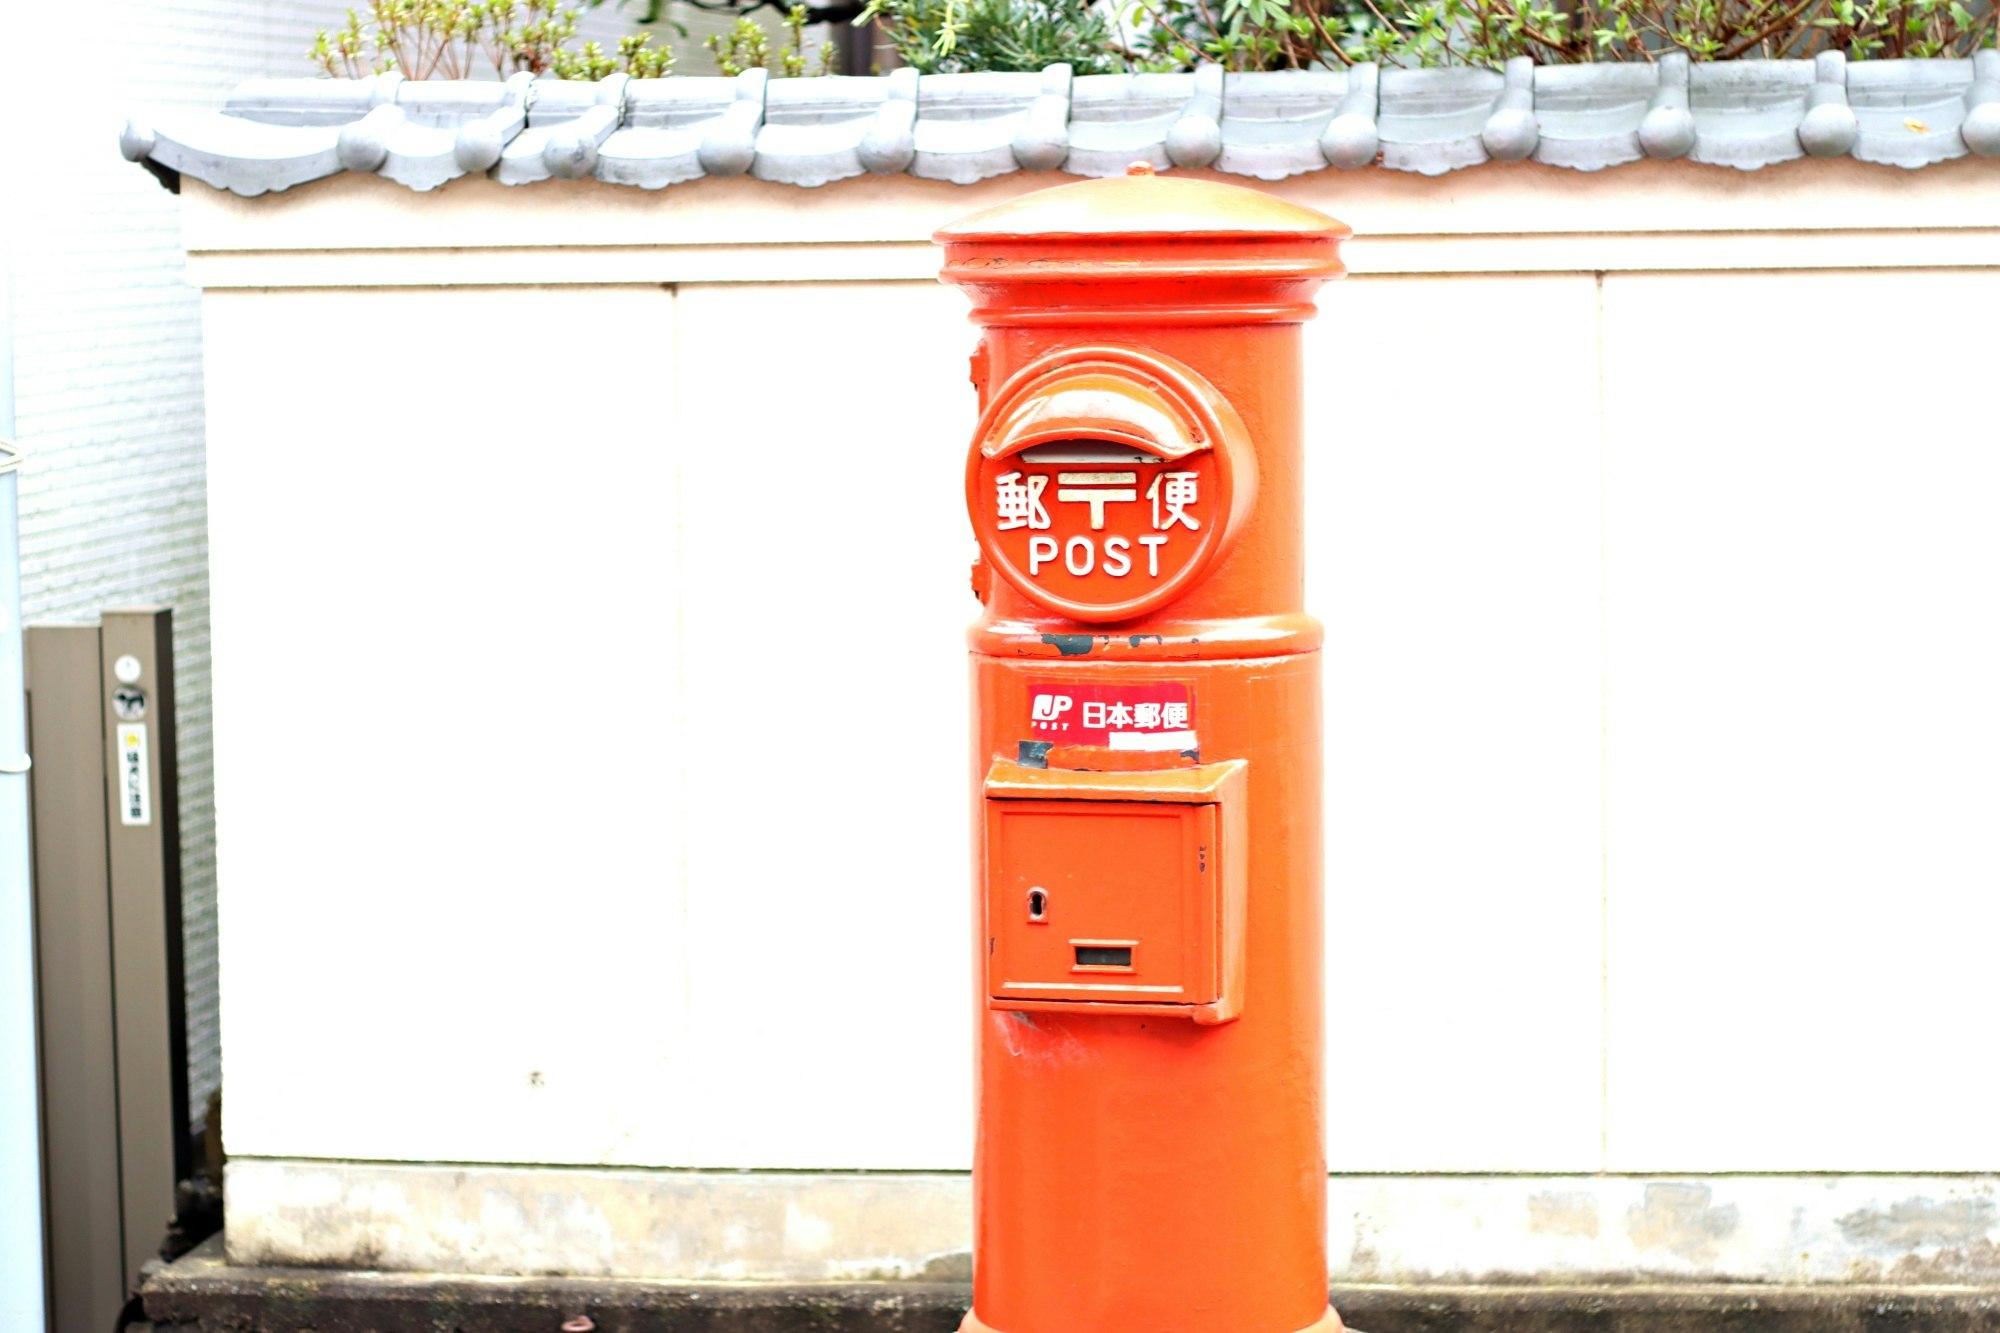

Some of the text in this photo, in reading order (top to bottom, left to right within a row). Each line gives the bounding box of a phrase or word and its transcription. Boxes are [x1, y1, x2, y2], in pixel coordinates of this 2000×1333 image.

[1029, 535, 1168, 577] POST
[1031, 694, 1073, 721] JP
[1083, 701, 1189, 729] 日本郵便
[1031, 721, 1070, 731] POST
